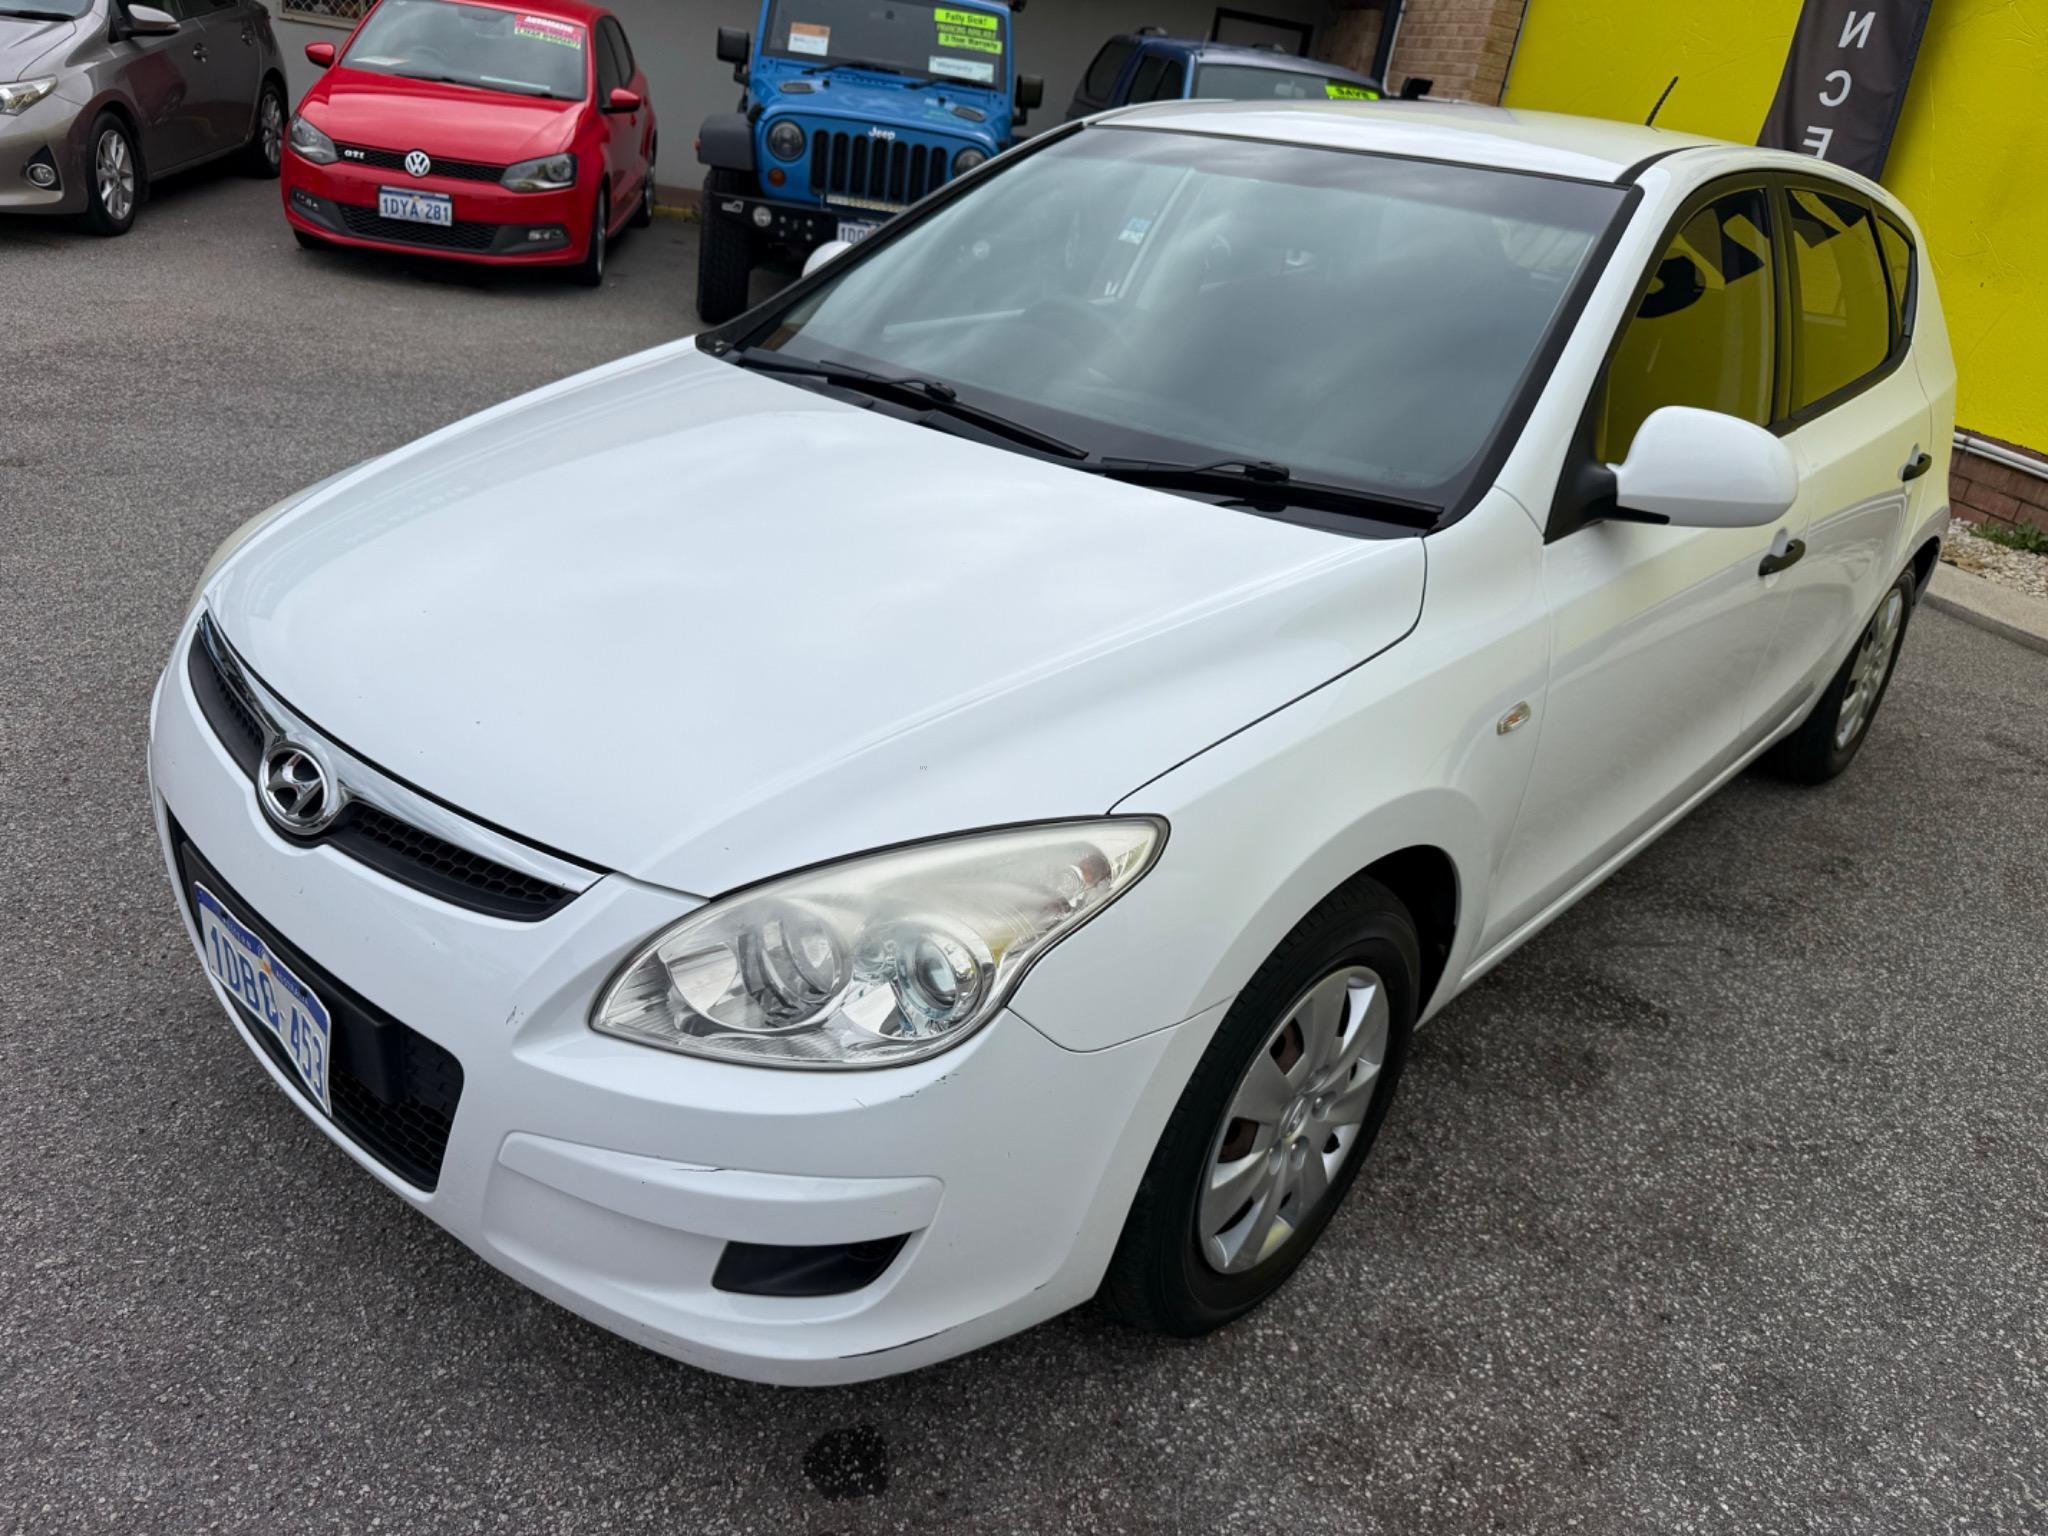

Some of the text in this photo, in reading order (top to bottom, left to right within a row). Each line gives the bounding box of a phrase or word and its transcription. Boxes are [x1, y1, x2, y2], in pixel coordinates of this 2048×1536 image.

[868, 126, 896, 141] Jeep
[343, 148, 366, 160] GTI
[383, 197, 449, 222] 1DYA 281
[210, 925, 325, 1099] 1DBC 453
